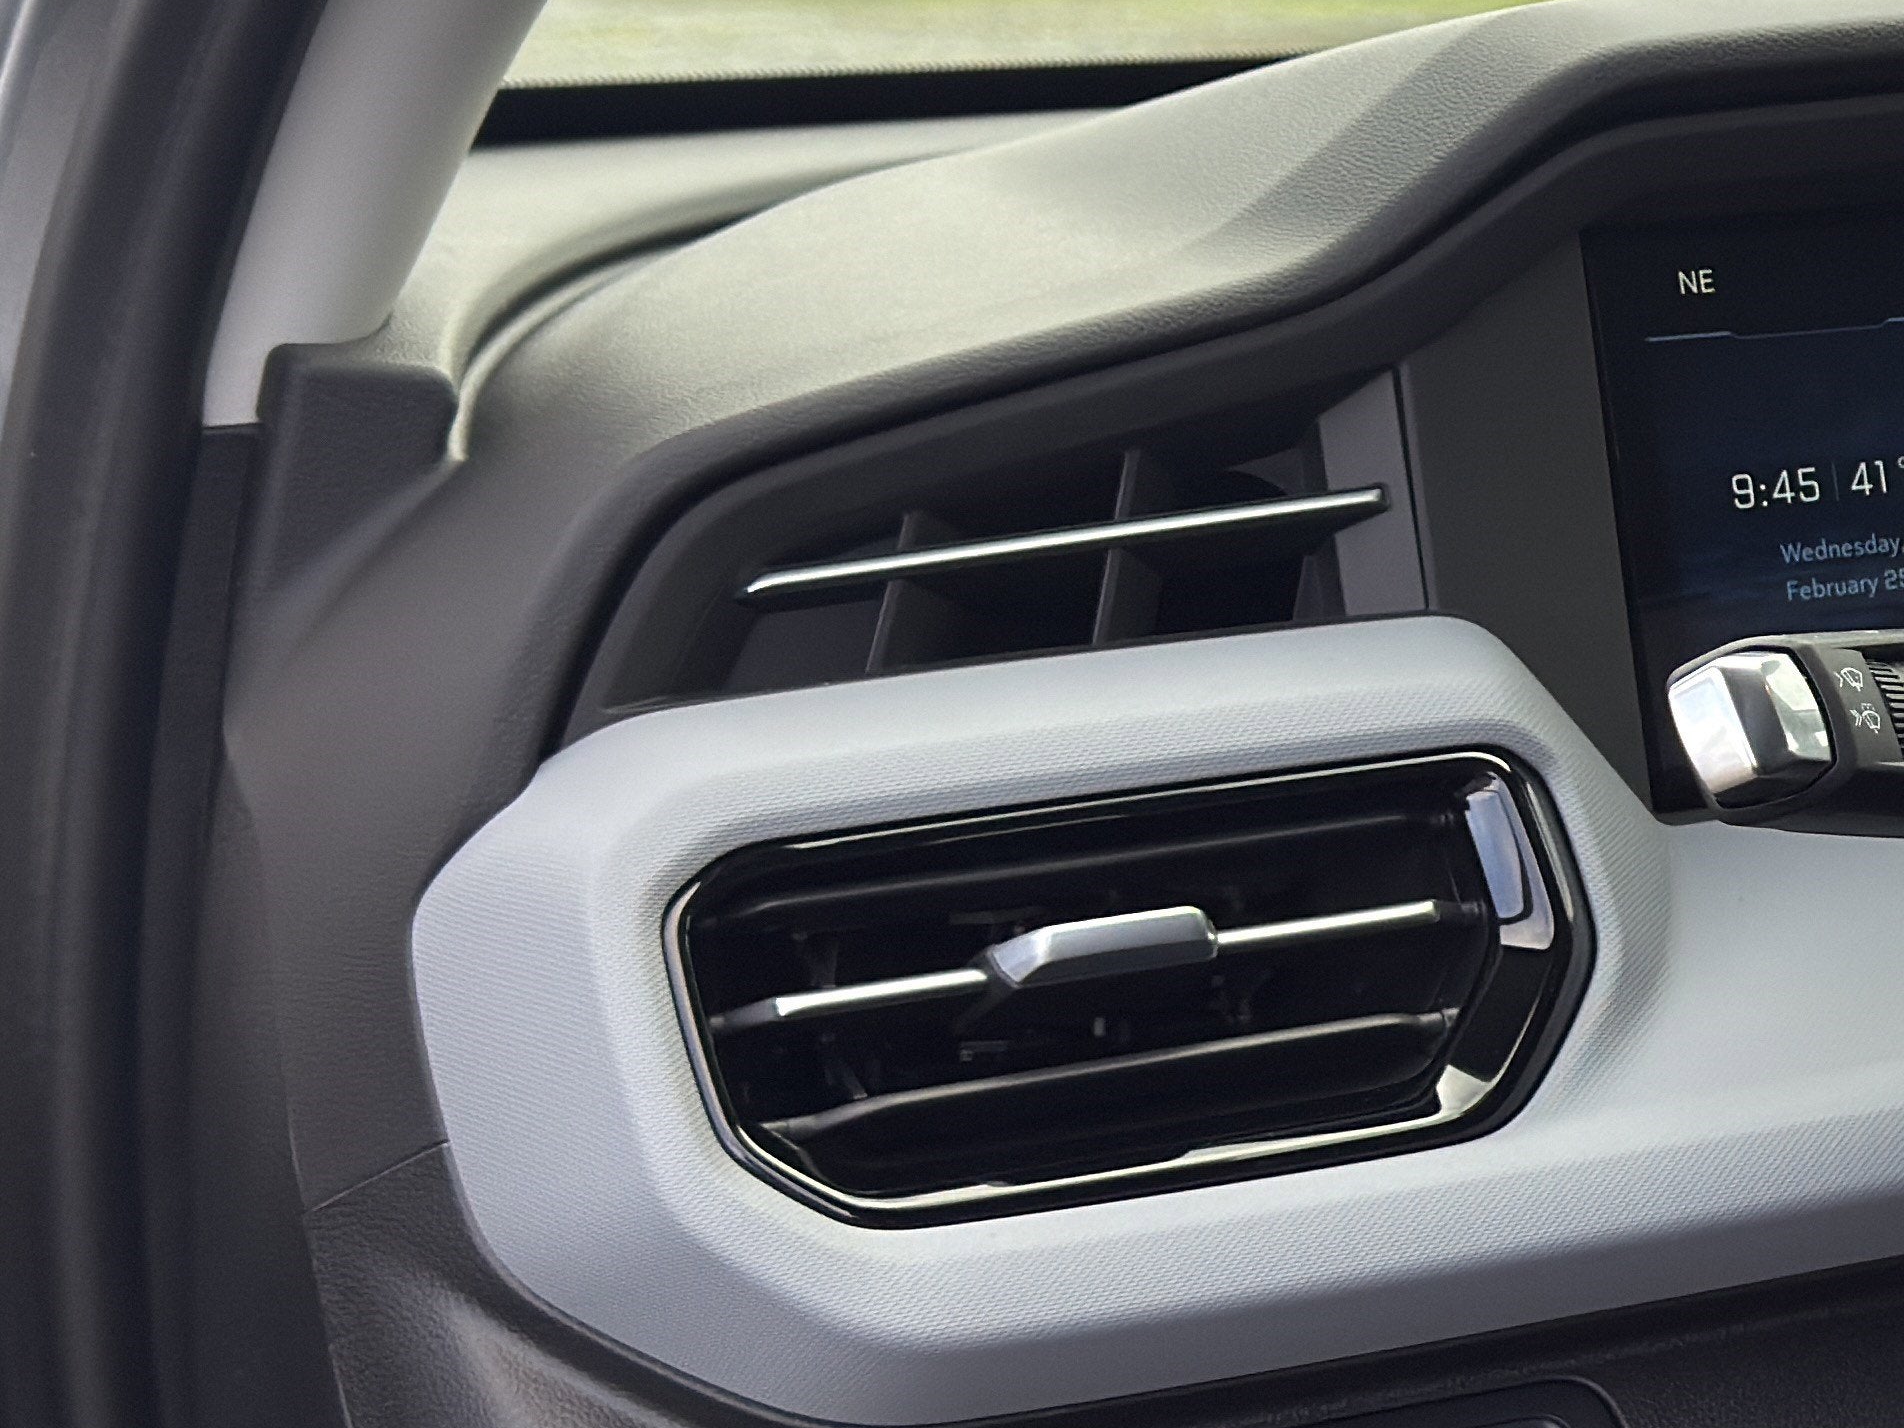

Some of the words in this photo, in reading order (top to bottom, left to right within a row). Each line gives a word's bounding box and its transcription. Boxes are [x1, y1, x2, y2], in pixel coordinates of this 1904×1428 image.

[1678, 268, 1716, 295] NE
[1731, 466, 1820, 510] 9:45
[1786, 575, 1879, 603] February
